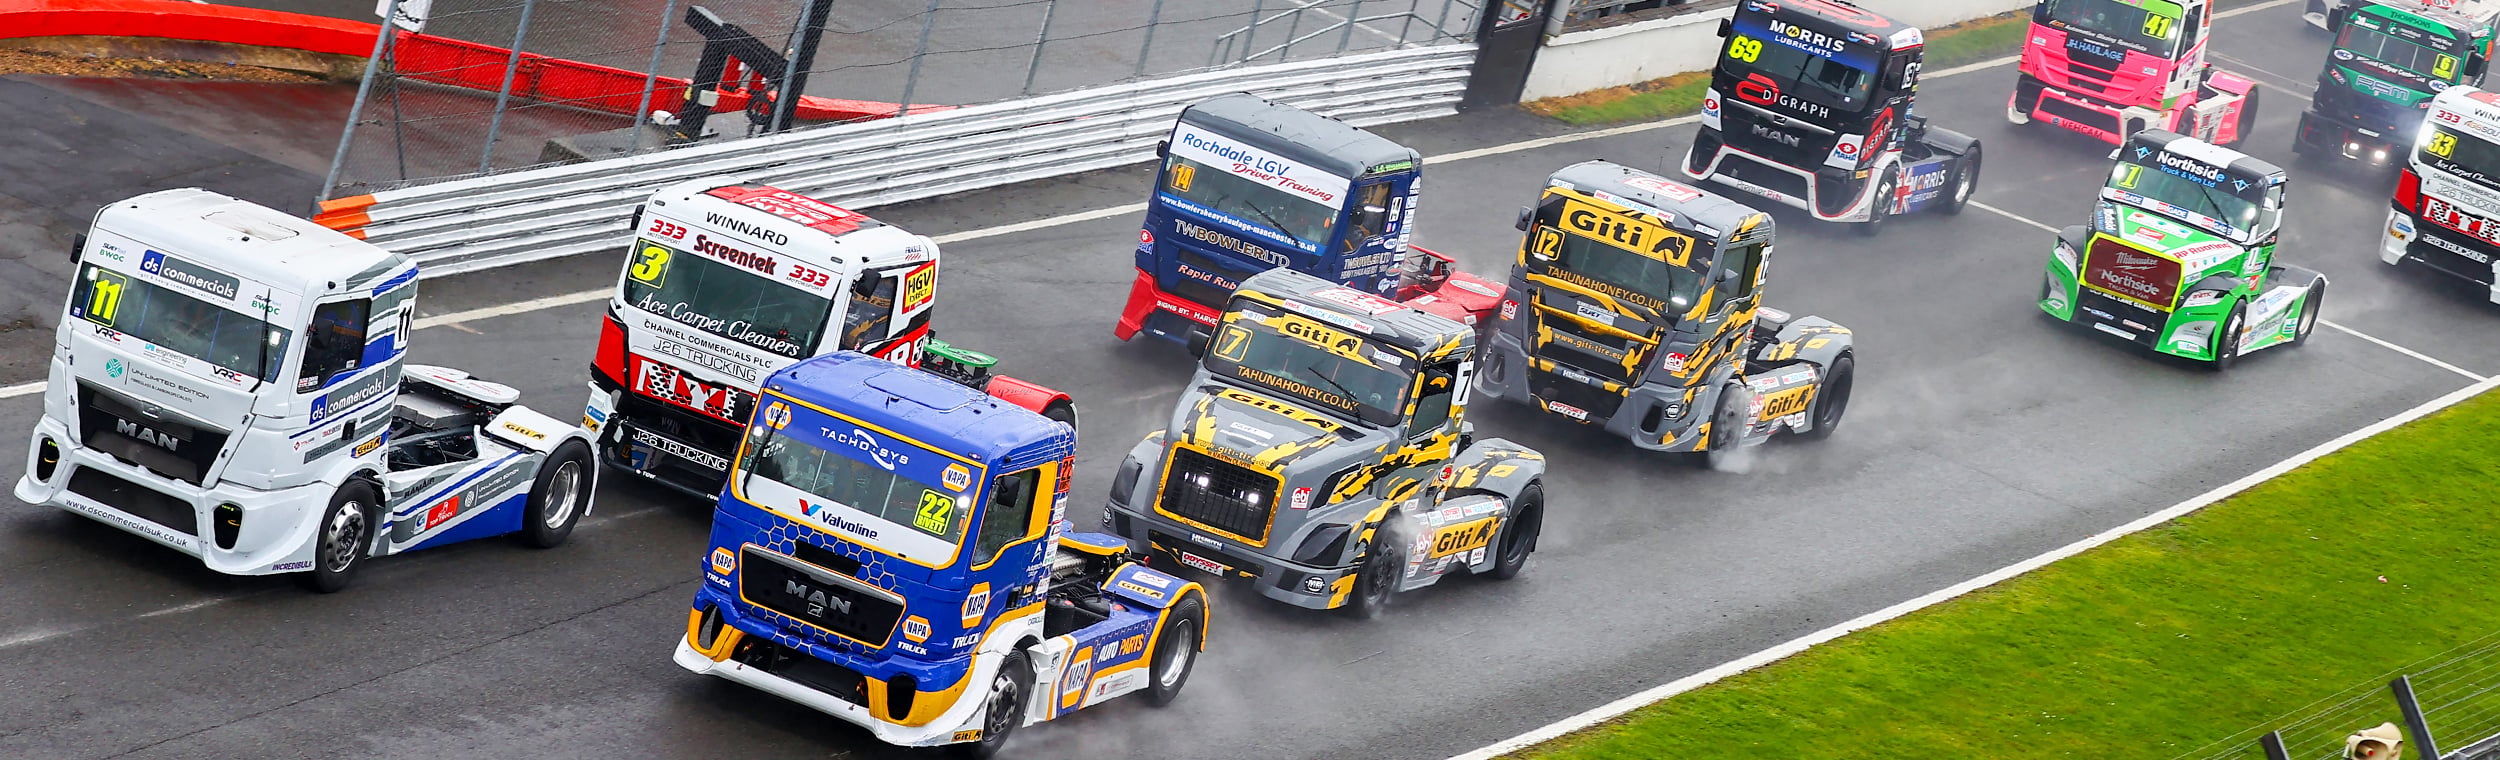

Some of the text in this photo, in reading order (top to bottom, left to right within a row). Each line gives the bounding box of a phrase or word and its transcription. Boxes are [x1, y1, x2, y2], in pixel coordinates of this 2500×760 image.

[2145, 15, 2170, 37] 41
[2390, 11, 2431, 29] THOMPSONS
[1769, 20, 1845, 52] MORRIS
[1774, 35, 1833, 58] LUBRICANTS
[1728, 35, 1763, 63] 69
[2440, 57, 2451, 70] 6
[1763, 89, 1829, 119] DIGRAPH
[2436, 109, 2462, 124] 333
[1752, 124, 1800, 148] MAN
[2427, 132, 2455, 157] 33
[1183, 133, 1290, 176] Rochdale LGV
[1833, 150, 1857, 161] MAHA
[2156, 149, 2226, 183] Northside
[1176, 166, 1192, 190] 14
[1232, 162, 1335, 201] Driver Training
[1910, 169, 1946, 192] MORRIS
[2121, 165, 2141, 187] 1
[2159, 163, 2216, 189] Truck & Van Ltd
[2448, 163, 2473, 179] Carpet
[2114, 190, 2144, 206] BRIGADE
[2157, 201, 2189, 219] BRIGADE
[650, 219, 687, 240] 333
[706, 211, 789, 246] WINNARD
[1569, 210, 1643, 247] Giti
[100, 249, 125, 262] BWOC
[693, 234, 779, 276] Screentek
[1537, 230, 1559, 257] 12
[2443, 241, 2488, 265] TRUCKING
[632, 246, 669, 281] 3
[788, 264, 830, 288] 333
[144, 257, 235, 298] ds commercials
[908, 269, 932, 295] HGV
[1178, 264, 1237, 291] Rapid Rub
[1547, 265, 1665, 312] TAHUNAHONEY.CO.UK
[2101, 268, 2160, 296] Northside
[91, 279, 121, 320] 11
[910, 288, 928, 303] DIRECT
[1156, 300, 1177, 311] SIGNS
[94, 325, 122, 342] VRRC
[399, 306, 413, 342] 11
[636, 293, 800, 357] Ace Carpet Cleaners
[1285, 321, 1330, 344] Giti
[644, 320, 772, 369] CHANNEL COMMERCIALS PLC
[1223, 330, 1247, 355] 7
[1554, 332, 1623, 361] www.giti-tire.eu
[652, 337, 757, 383] J26 TRUCKING
[1666, 352, 1685, 368] febi
[213, 365, 243, 383] VRRC
[1459, 370, 1472, 401] 7
[178, 385, 210, 400] EDITION
[312, 404, 324, 420] ds
[329, 379, 383, 414] commercials
[1238, 365, 1359, 411] TAHUNAHONEY.CO.UK
[766, 406, 791, 424] NAPA
[1228, 393, 1295, 416] Giti
[1766, 393, 1795, 416] Giti
[116, 418, 179, 452] MAN
[632, 429, 728, 471] J26 TRUCKING
[945, 469, 968, 488] NAPA
[920, 493, 950, 522] 22
[1292, 487, 1310, 504] febi
[65, 498, 188, 548] www.dscommercialsuk.co.uk
[821, 509, 878, 541] Valvoline
[915, 515, 945, 533] RIVETT
[1437, 527, 1474, 553] Giti
[713, 552, 734, 570] NAPA
[1184, 554, 1222, 569] ODYSSEY
[707, 571, 732, 589] TRUCK
[786, 579, 852, 615] MAN
[965, 593, 987, 620] NAPA
[905, 621, 928, 640] NAPA
[952, 631, 981, 649] TRUCK
[897, 641, 927, 656] TRUCK
[1097, 633, 1145, 664] AUTO PARTS
[1066, 661, 1089, 692] NAPA
[954, 731, 972, 742] Giti
